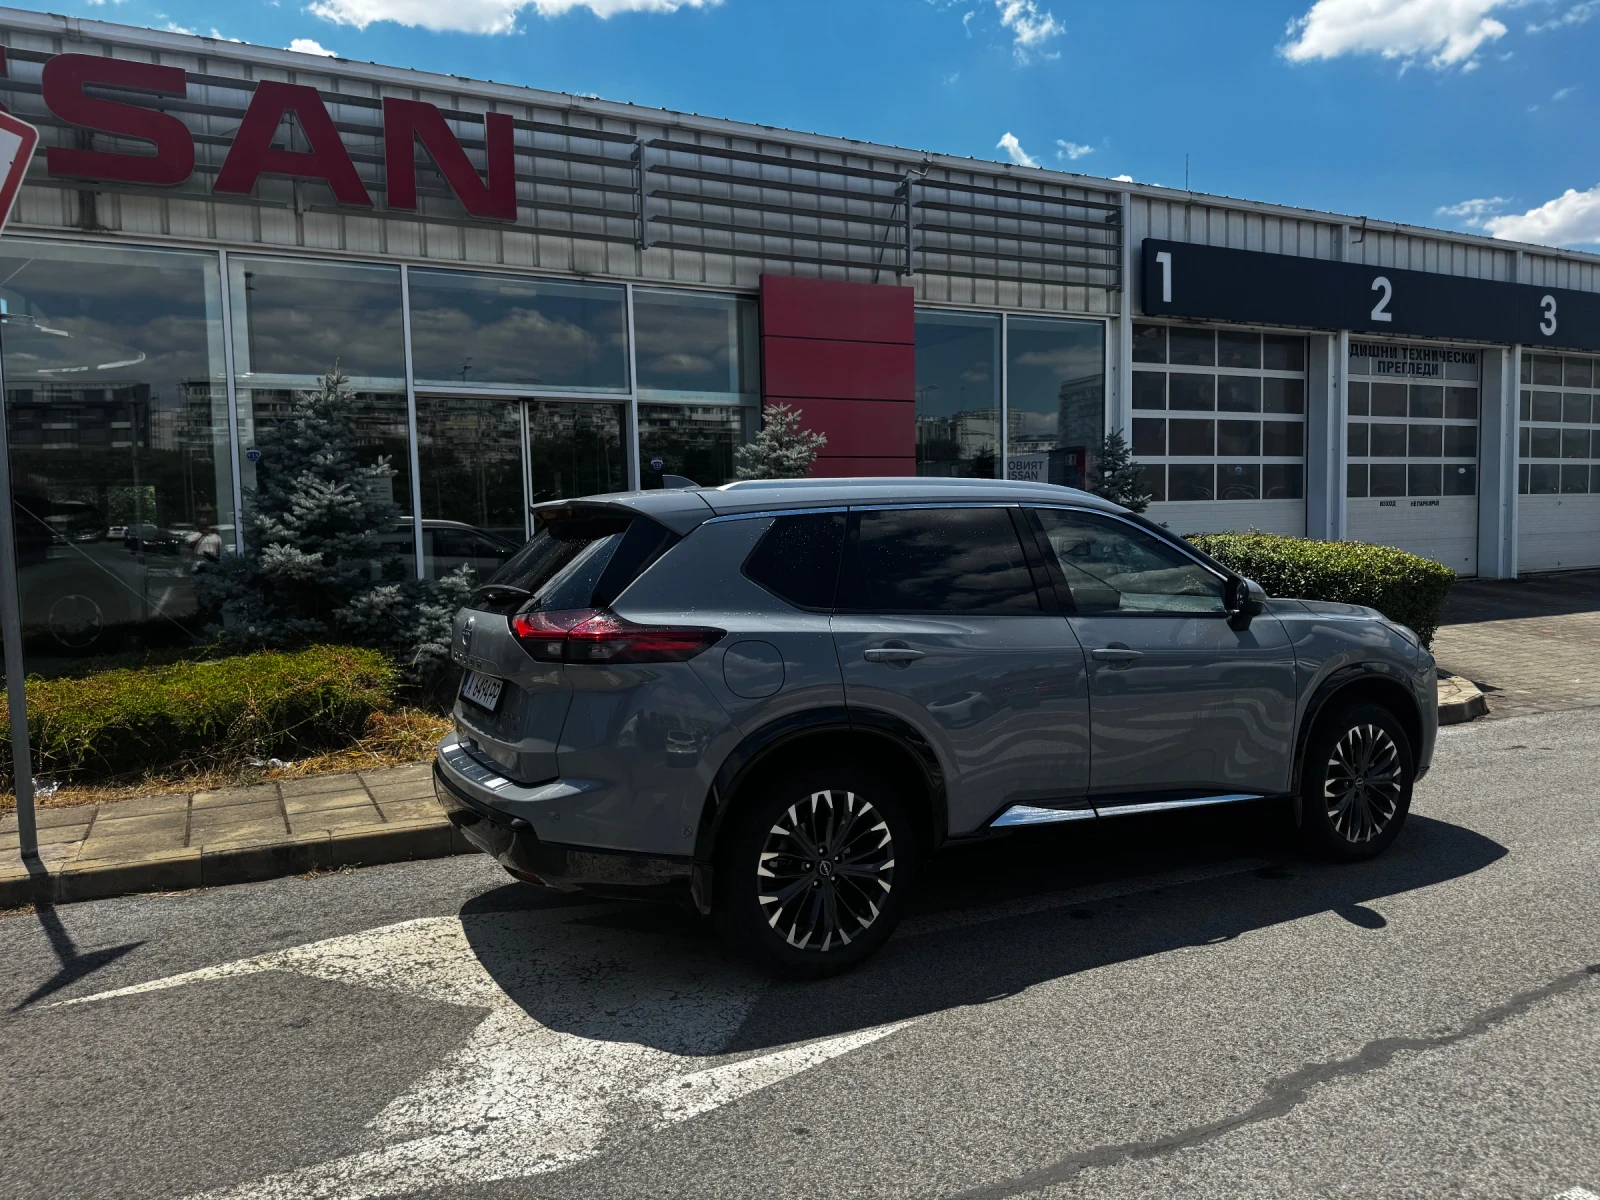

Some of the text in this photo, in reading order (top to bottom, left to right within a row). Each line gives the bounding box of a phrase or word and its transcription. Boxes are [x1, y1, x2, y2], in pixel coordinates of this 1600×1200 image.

[0, 45, 518, 222] SAN
[1155, 251, 1172, 303] 1
[1370, 276, 1393, 322] 2
[1539, 294, 1558, 337] 3
[1377, 361, 1438, 376] ПРЕГЛЕДИ
[1401, 347, 1475, 364] ТЕХНИЧЕСКИ
[1008, 461, 1044, 470] ОВИЯТ
